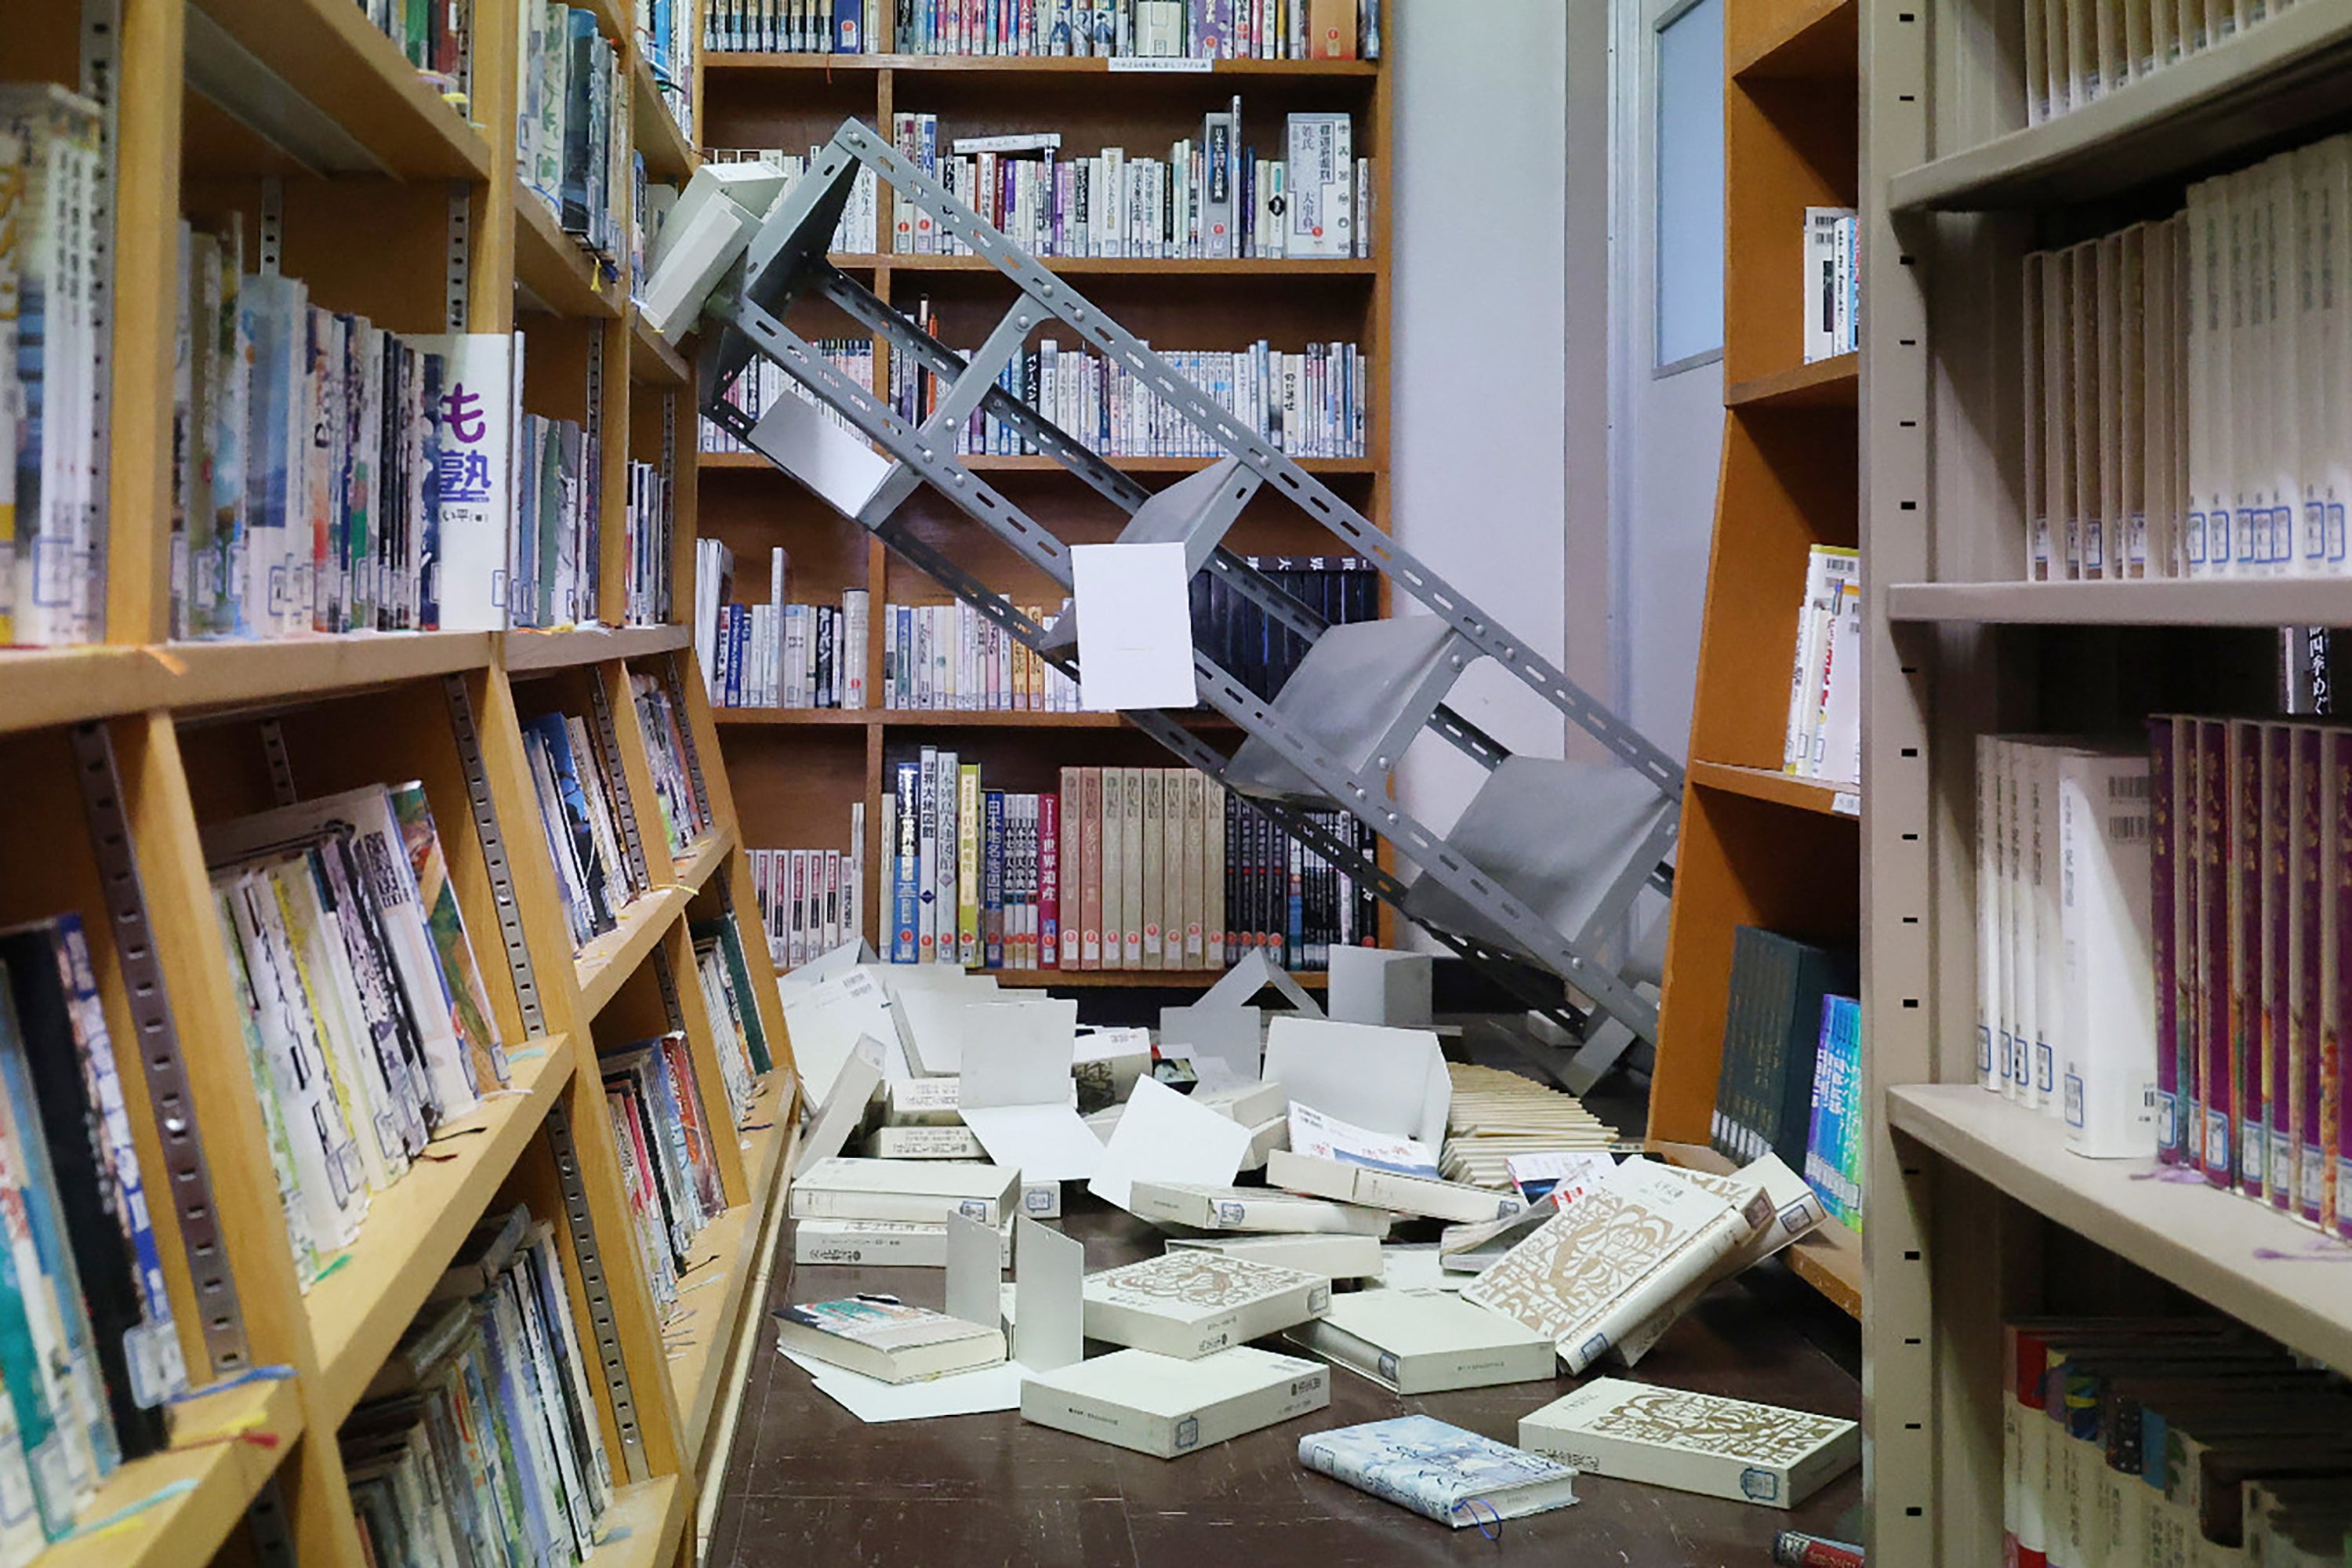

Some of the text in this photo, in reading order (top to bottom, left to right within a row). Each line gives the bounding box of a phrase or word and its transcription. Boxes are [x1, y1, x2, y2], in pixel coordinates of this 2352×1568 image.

[441, 381, 486, 445] も
[439, 448, 492, 503] 塾
[1042, 839, 1057, 901] 世界遺産
